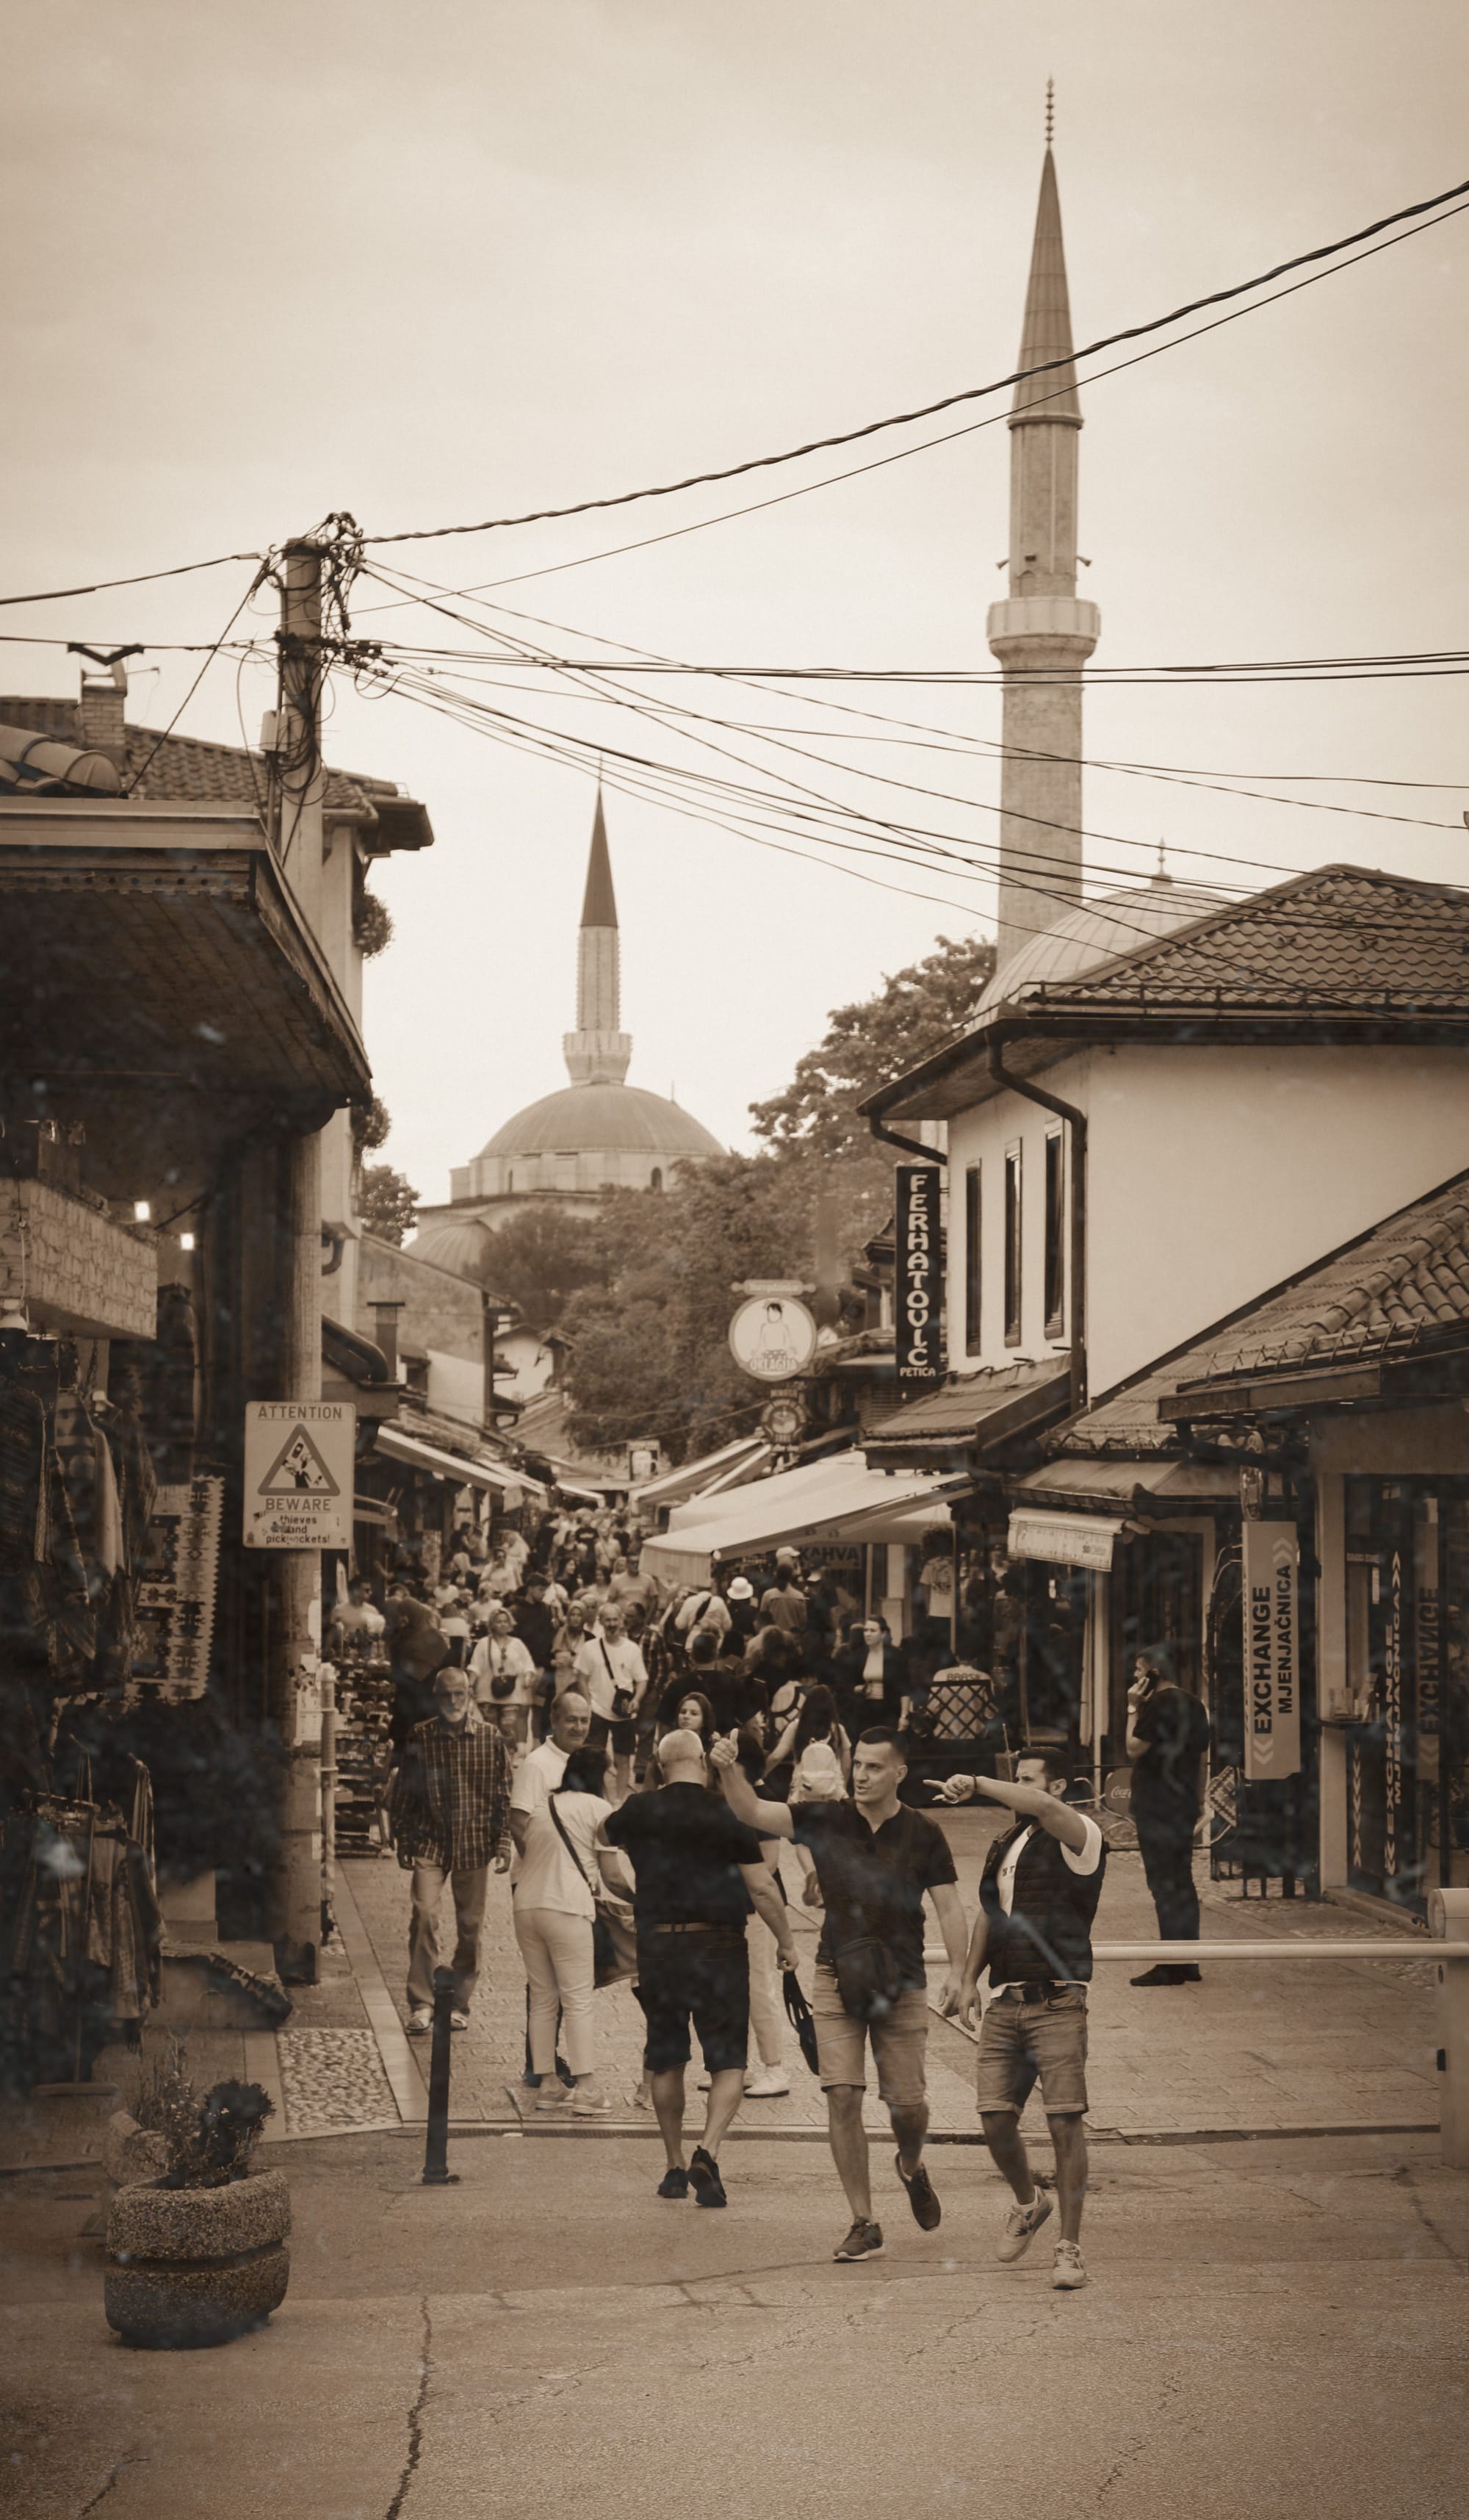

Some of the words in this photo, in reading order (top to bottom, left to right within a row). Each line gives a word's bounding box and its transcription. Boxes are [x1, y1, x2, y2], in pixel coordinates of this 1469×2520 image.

[900, 1367, 936, 1377] PETICA
[259, 1405, 342, 1419] ATTENTION
[265, 1498, 331, 1511] BEWARE
[280, 1514, 317, 1524] thieves
[1275, 1565, 1292, 1714] MJENJAČNICA
[1252, 1587, 1272, 1734] EXCHANGE
[1385, 1624, 1393, 1835] EXCHANGE
